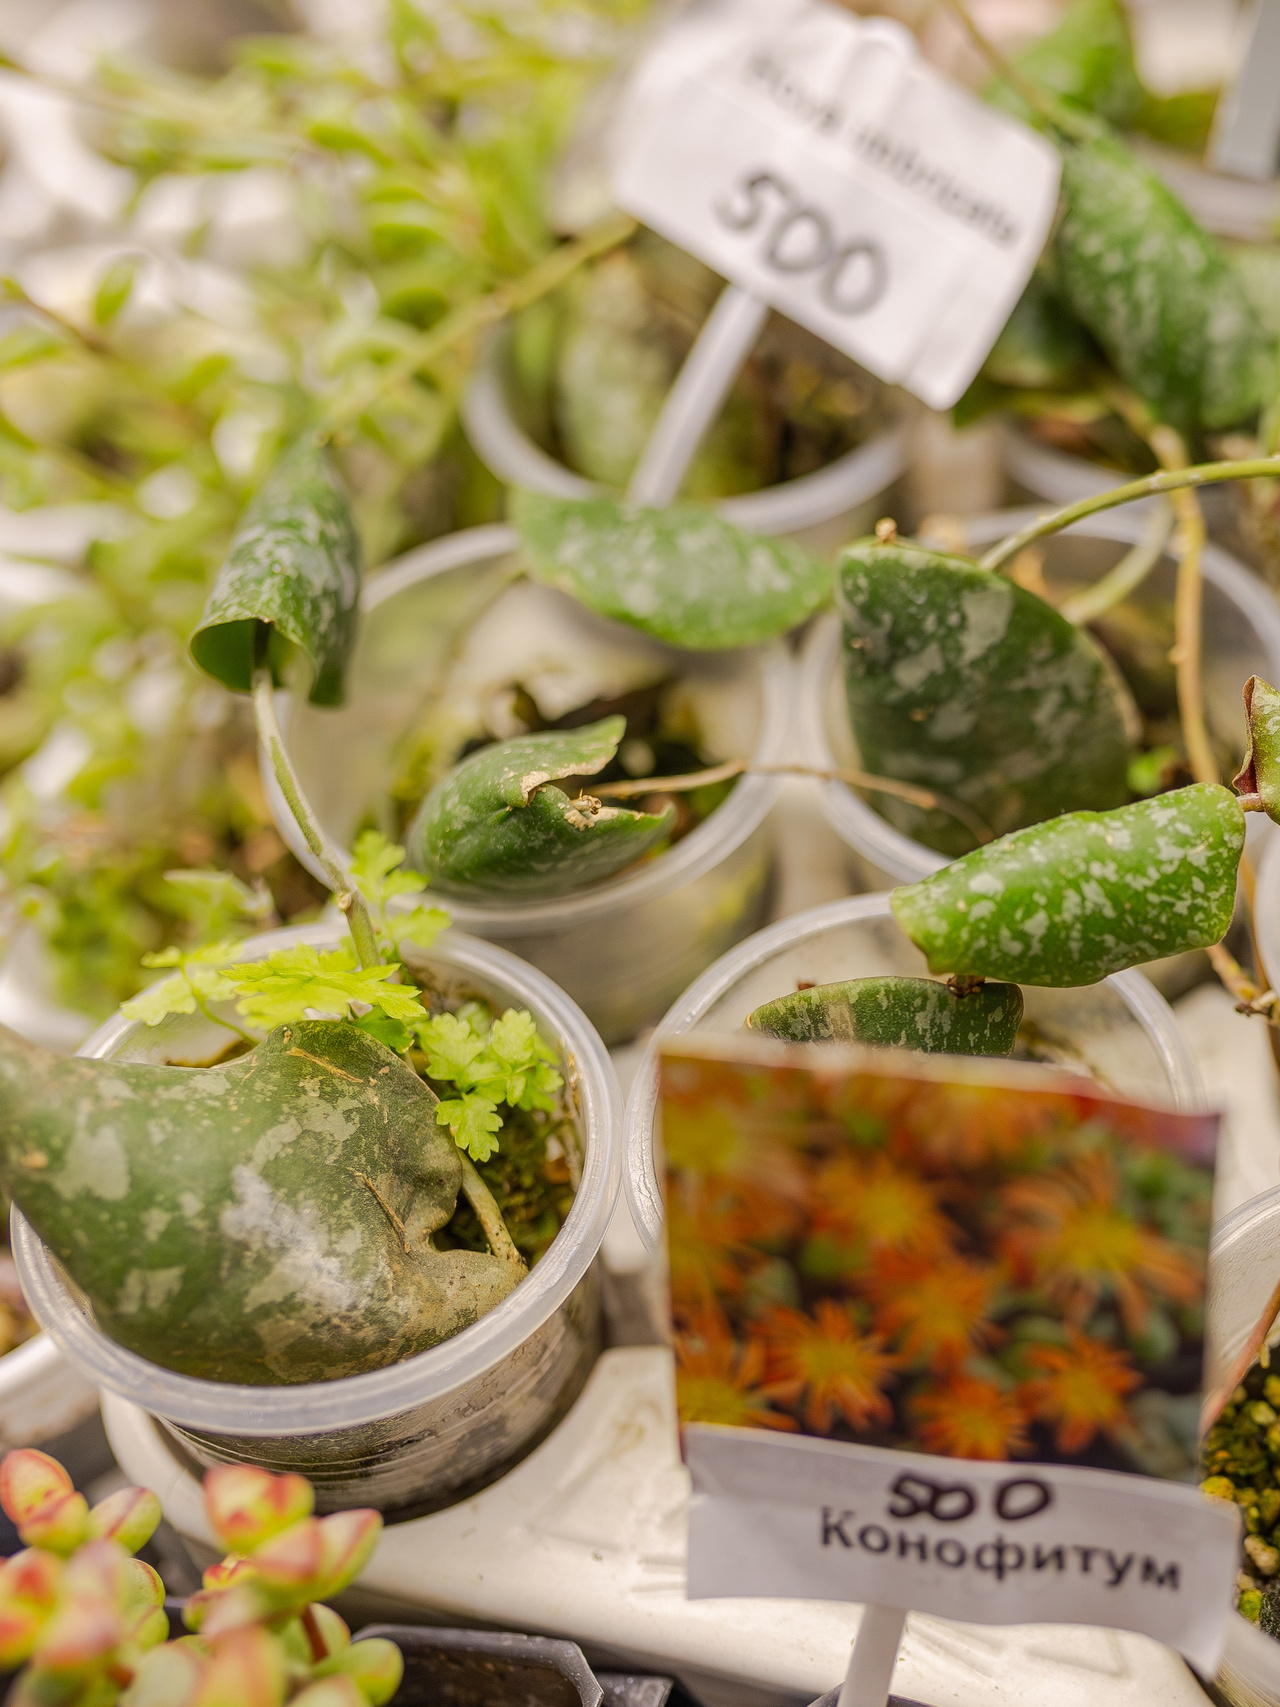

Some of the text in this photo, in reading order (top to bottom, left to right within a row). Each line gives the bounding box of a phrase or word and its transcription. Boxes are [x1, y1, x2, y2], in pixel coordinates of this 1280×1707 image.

[712, 167, 887, 315] 500
[886, 1471, 1054, 1522] 500
[819, 1506, 1182, 1592] Конофитум
